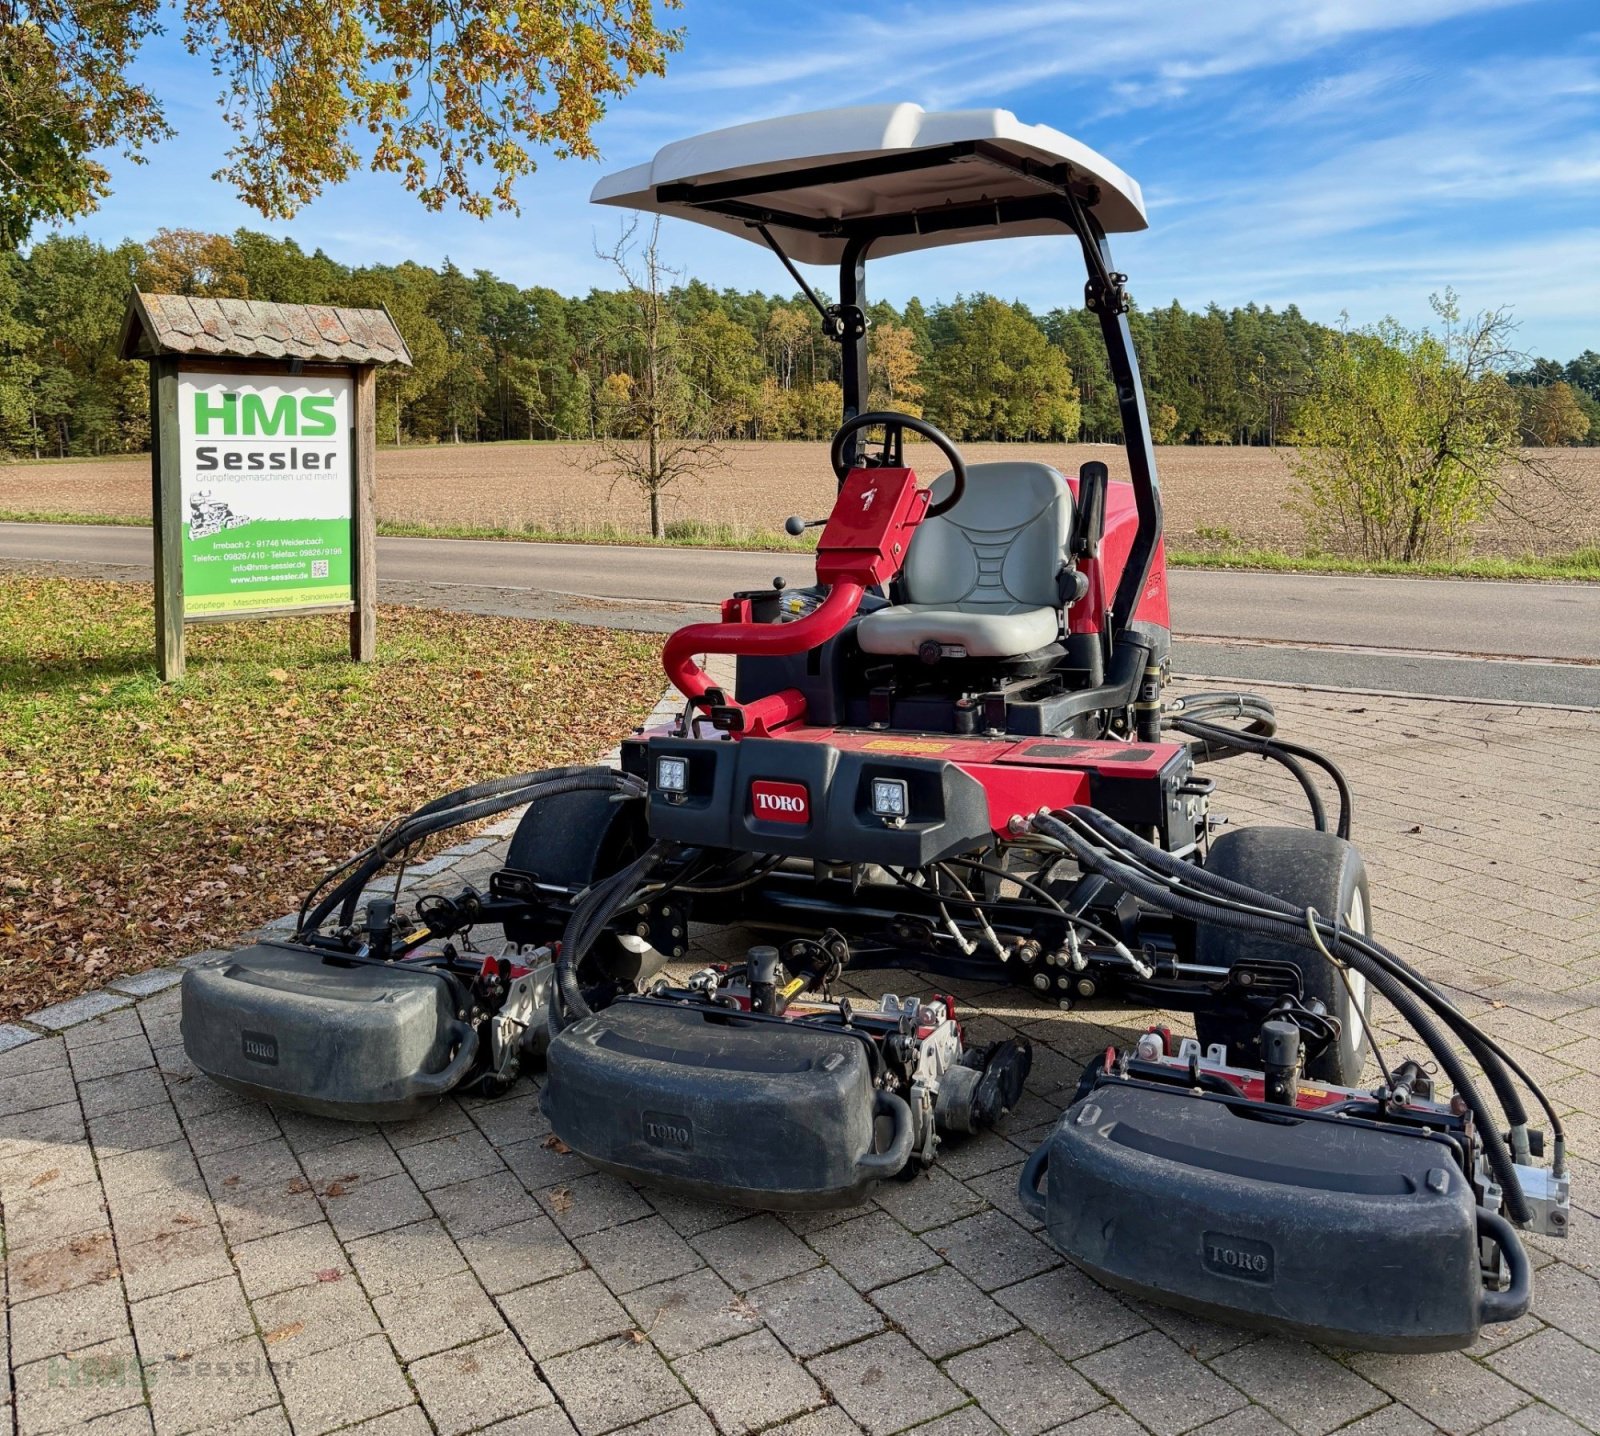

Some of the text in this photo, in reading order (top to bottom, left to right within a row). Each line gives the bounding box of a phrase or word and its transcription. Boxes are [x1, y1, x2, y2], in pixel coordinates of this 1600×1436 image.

[194, 392, 337, 436] HMS
[196, 447, 337, 471] Sessler
[295, 473, 313, 481] und
[245, 540, 251, 548] 2
[280, 537, 324, 547] Weidenbach
[192, 553, 222, 562] Telefon:
[230, 572, 309, 584] www.hms-sessler.de
[756, 793, 805, 812] TORO
[245, 1040, 275, 1058] TORO
[647, 1122, 690, 1143] TORO
[1208, 1245, 1269, 1272] TORO
